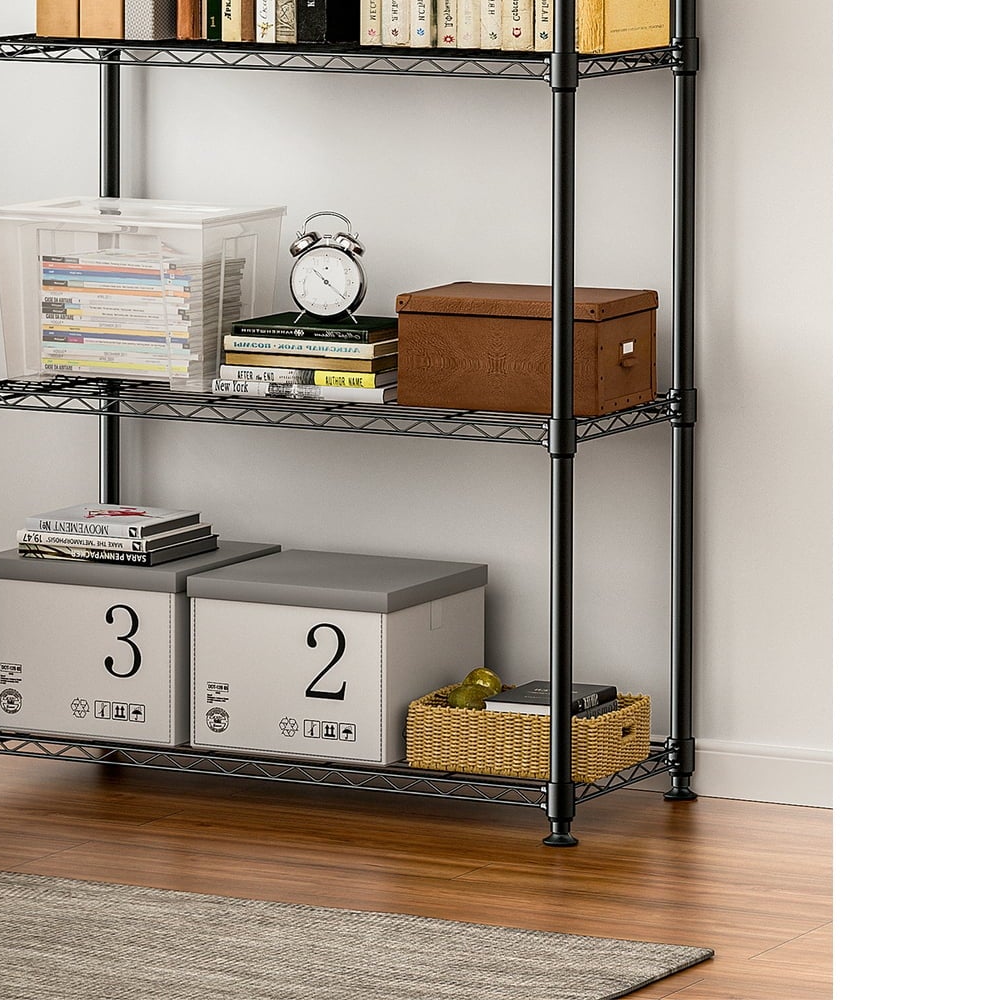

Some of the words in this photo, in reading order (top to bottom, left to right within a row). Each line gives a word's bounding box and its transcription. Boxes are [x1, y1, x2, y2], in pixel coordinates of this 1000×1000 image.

[238, 370, 254, 380] AFTER
[264, 372, 274, 381] END
[214, 380, 230, 392] New
[232, 380, 248, 392] York
[326, 376, 346, 386] AUTHOR
[348, 378, 364, 387] NAME
[55, 520, 108, 536] MOOVEMENT
[22, 533, 42, 543] 19,47
[126, 554, 146, 562] SARA
[104, 604, 142, 678] 3
[305, 622, 346, 701] 2
